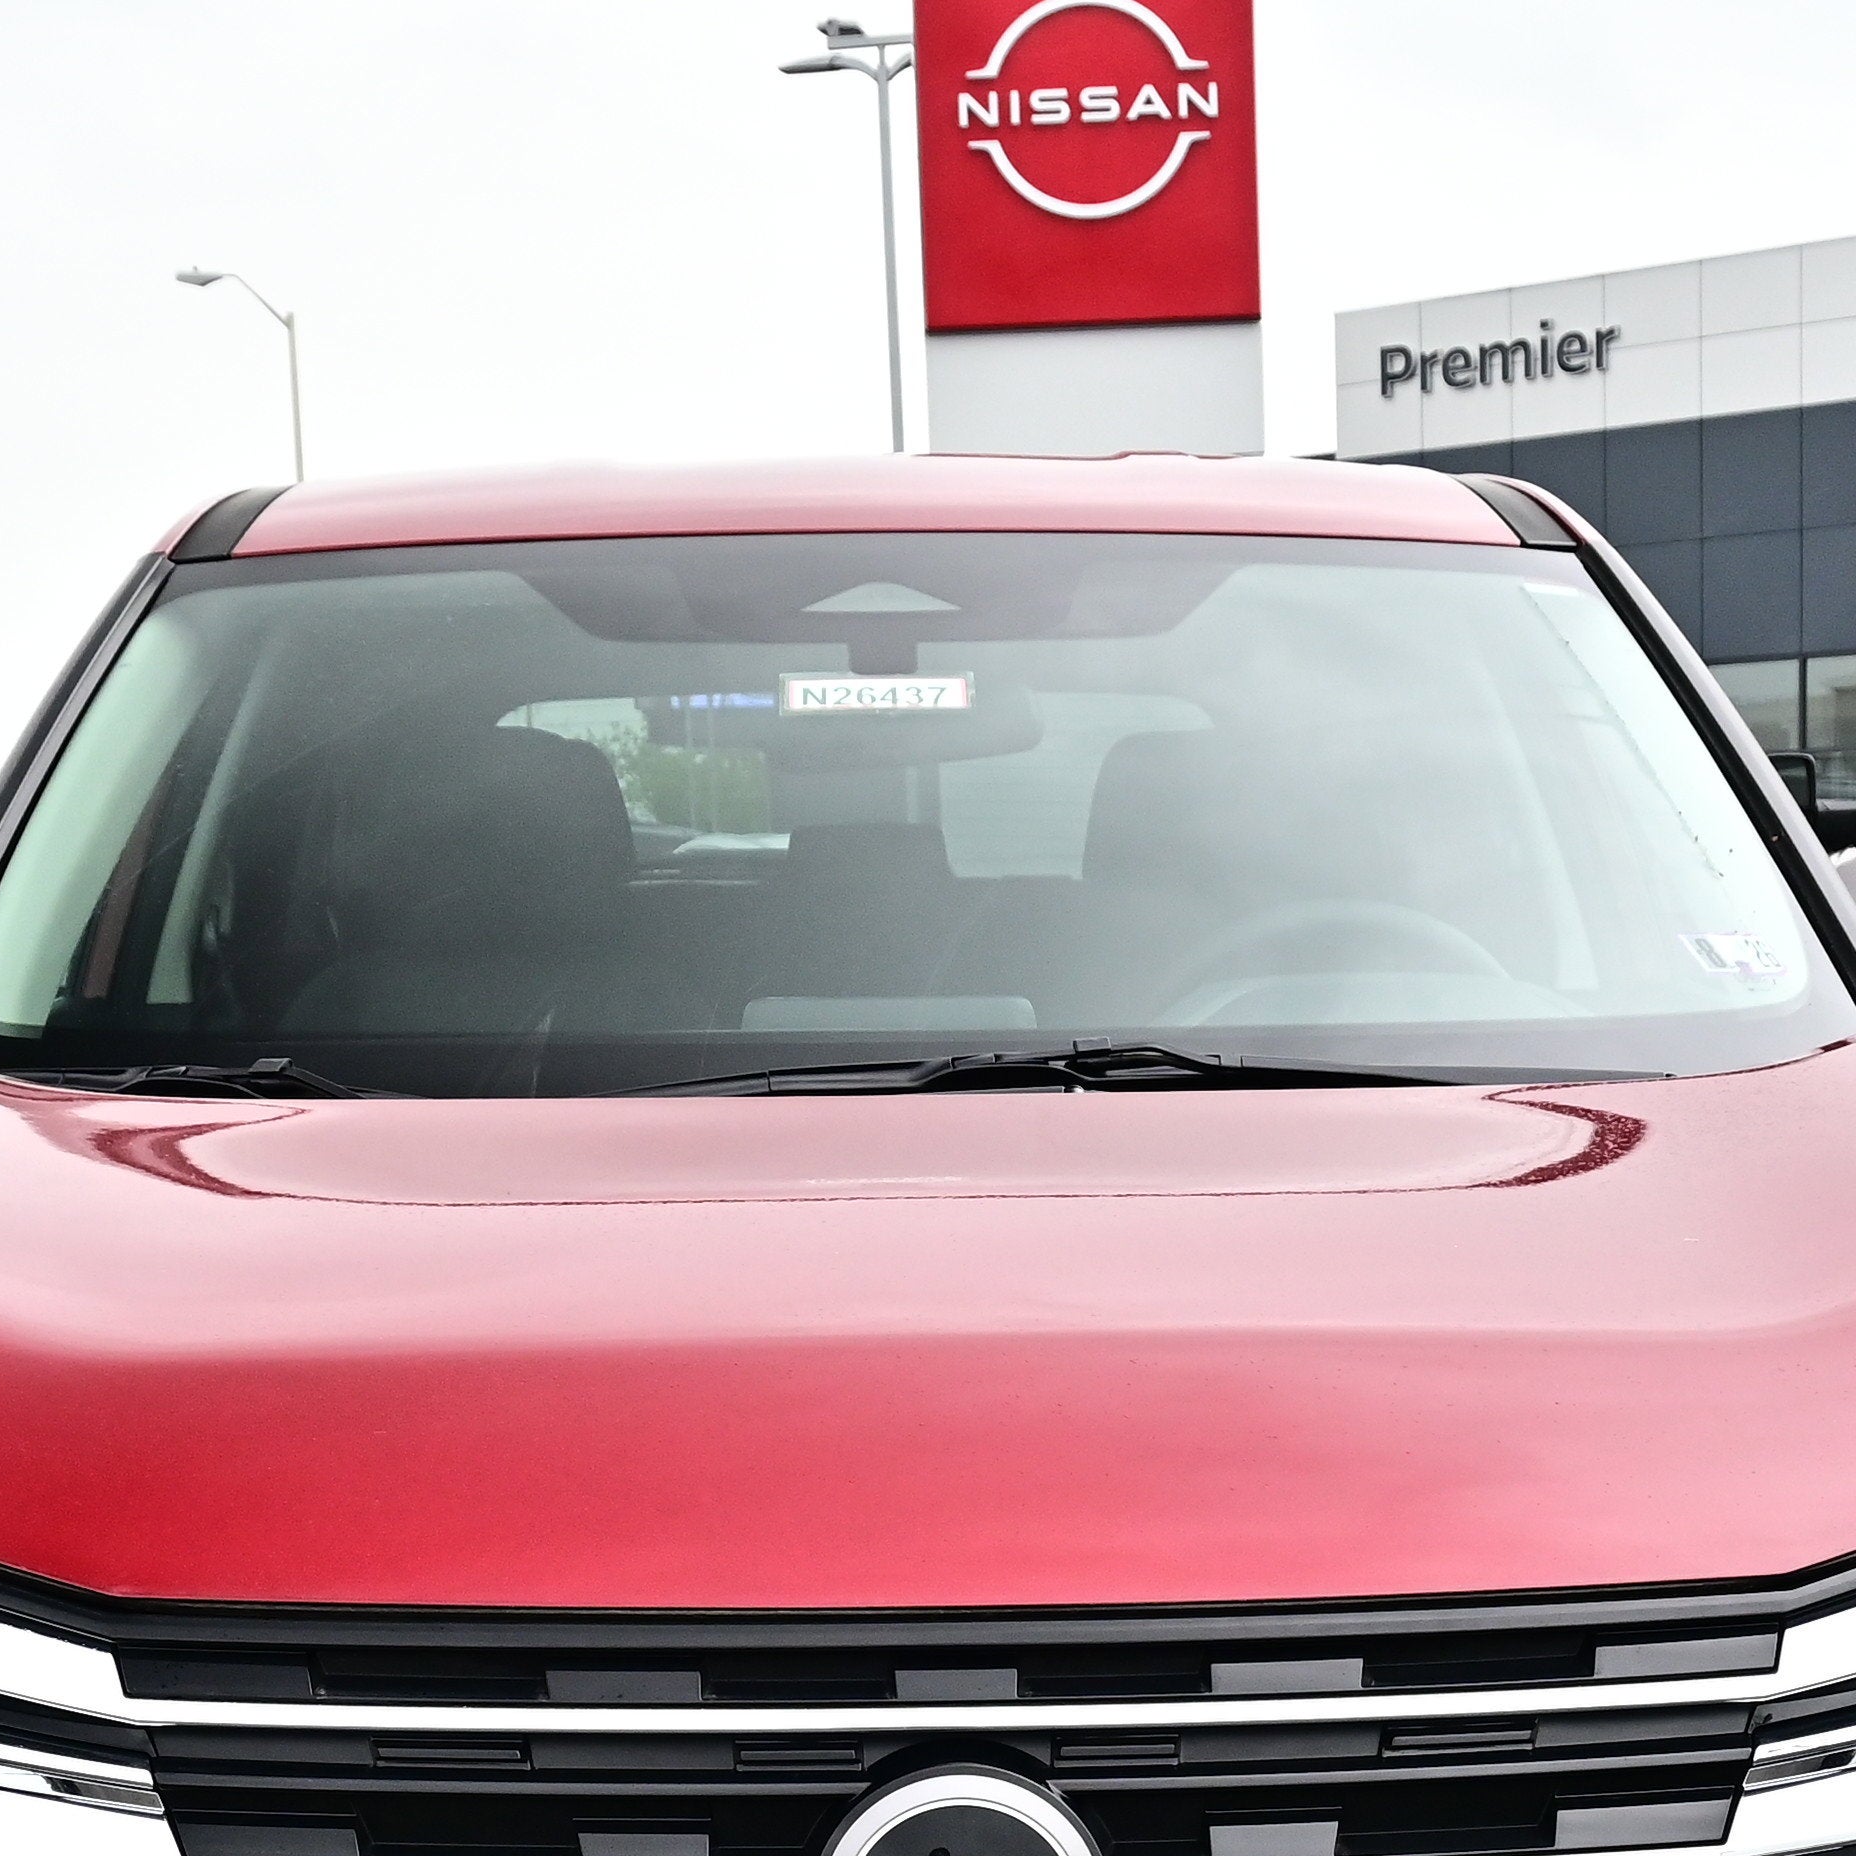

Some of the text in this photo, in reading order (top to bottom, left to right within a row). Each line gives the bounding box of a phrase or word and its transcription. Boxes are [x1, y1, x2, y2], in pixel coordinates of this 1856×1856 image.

[958, 81, 1219, 129] NISSAN
[1380, 318, 1620, 398] Premier
[801, 686, 948, 707] N26437
